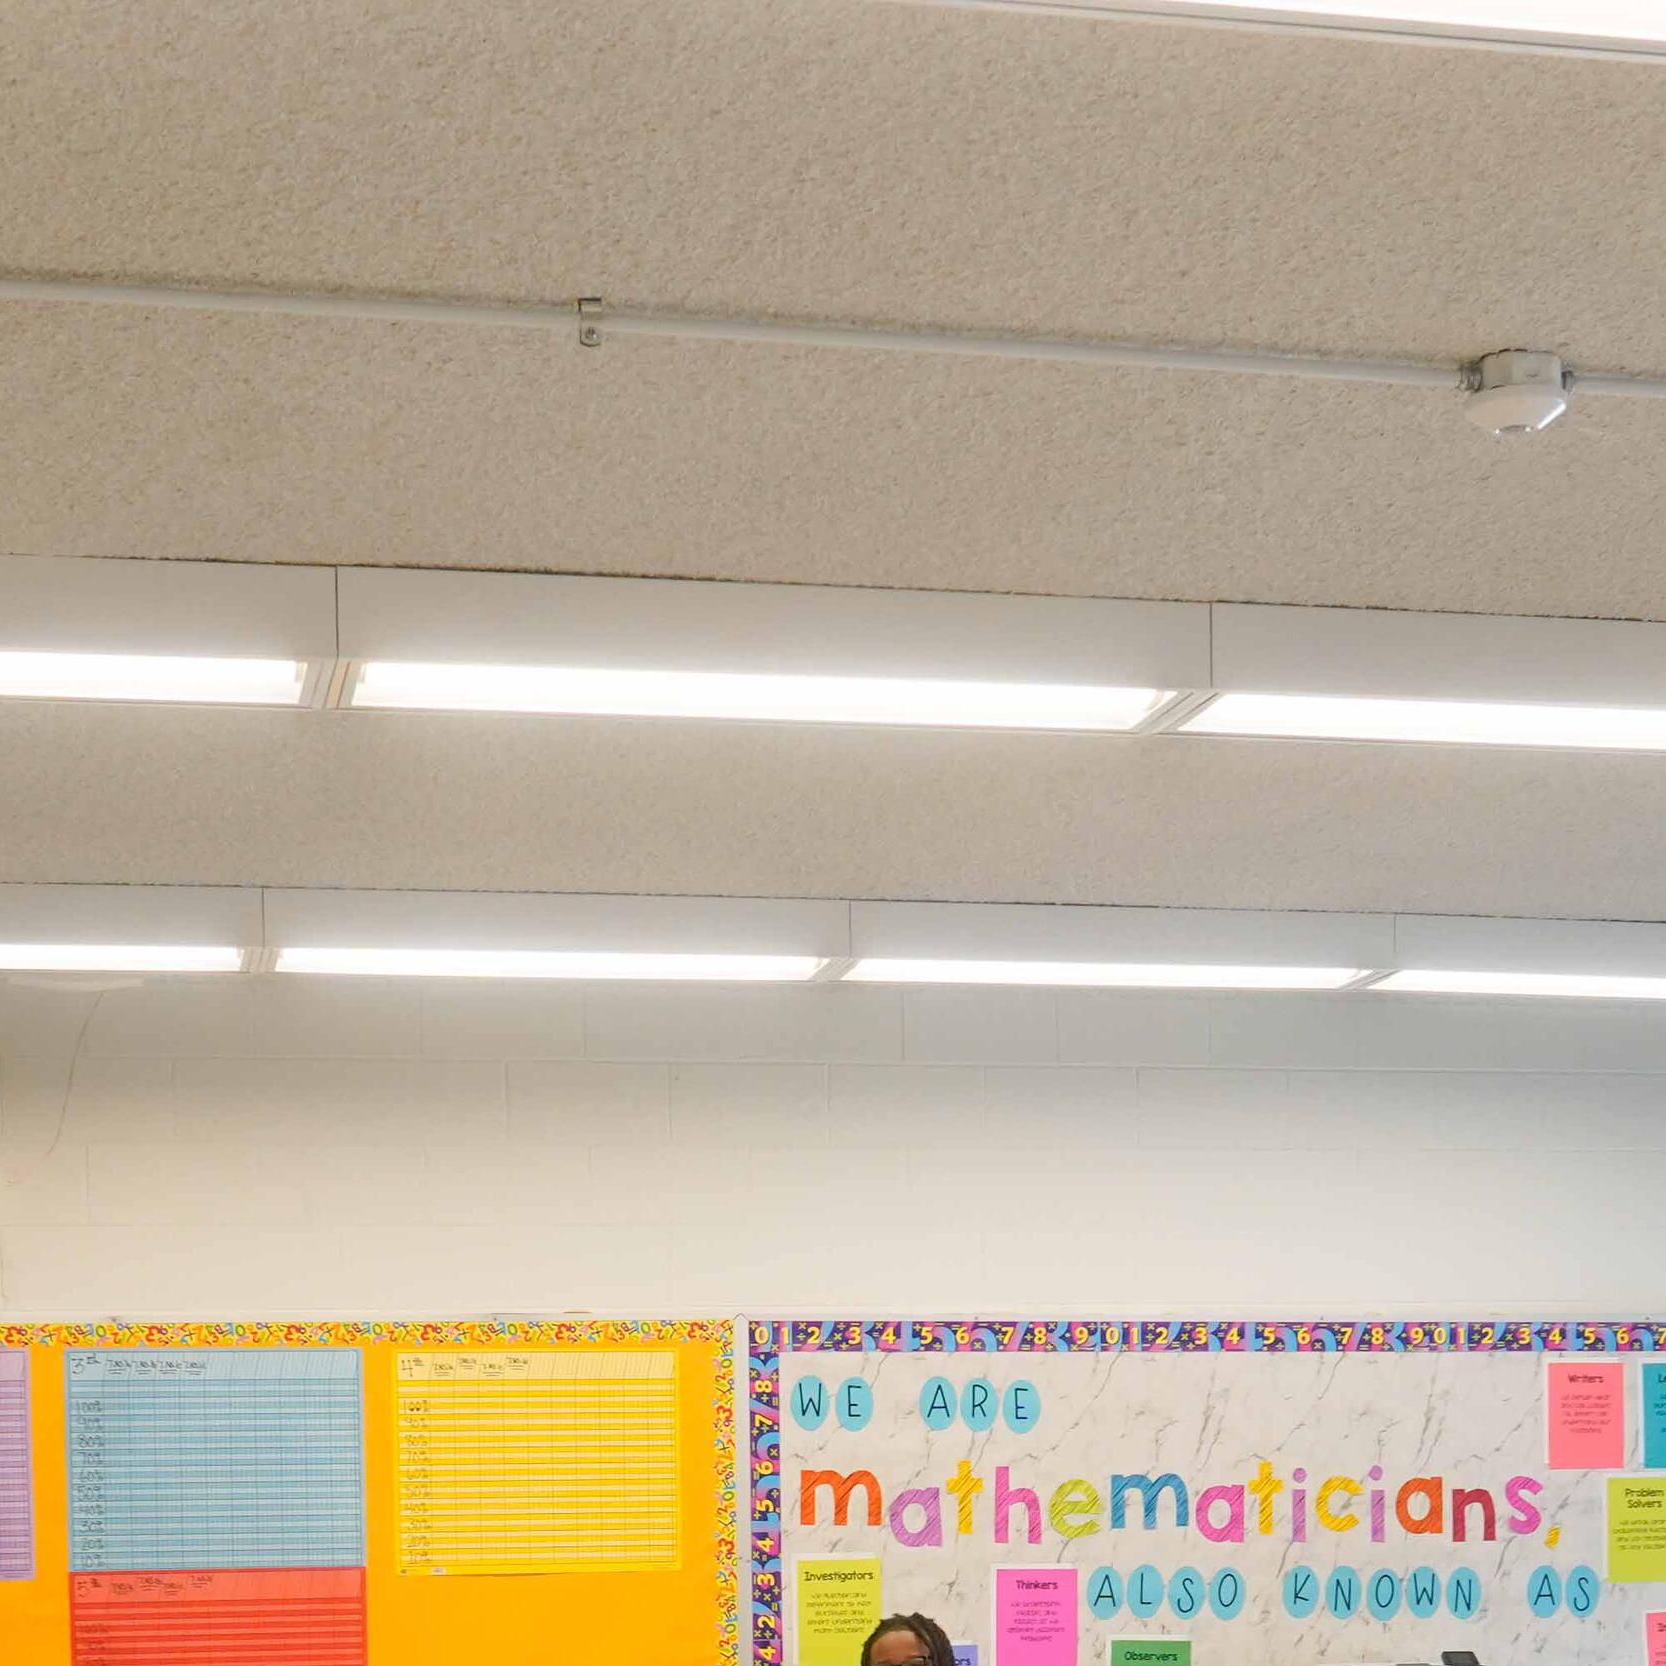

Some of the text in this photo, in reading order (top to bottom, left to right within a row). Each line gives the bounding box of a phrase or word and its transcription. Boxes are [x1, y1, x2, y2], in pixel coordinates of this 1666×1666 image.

[798, 1382, 1030, 1420] WE ARE
[799, 1459, 1560, 1549] mathematicians,
[804, 1571, 874, 1583] Investigators
[1016, 1580, 1058, 1589] Thinkers
[1093, 1572, 1592, 1613] ALSO KNOWN AS
[1125, 1651, 1179, 1661] Observers
